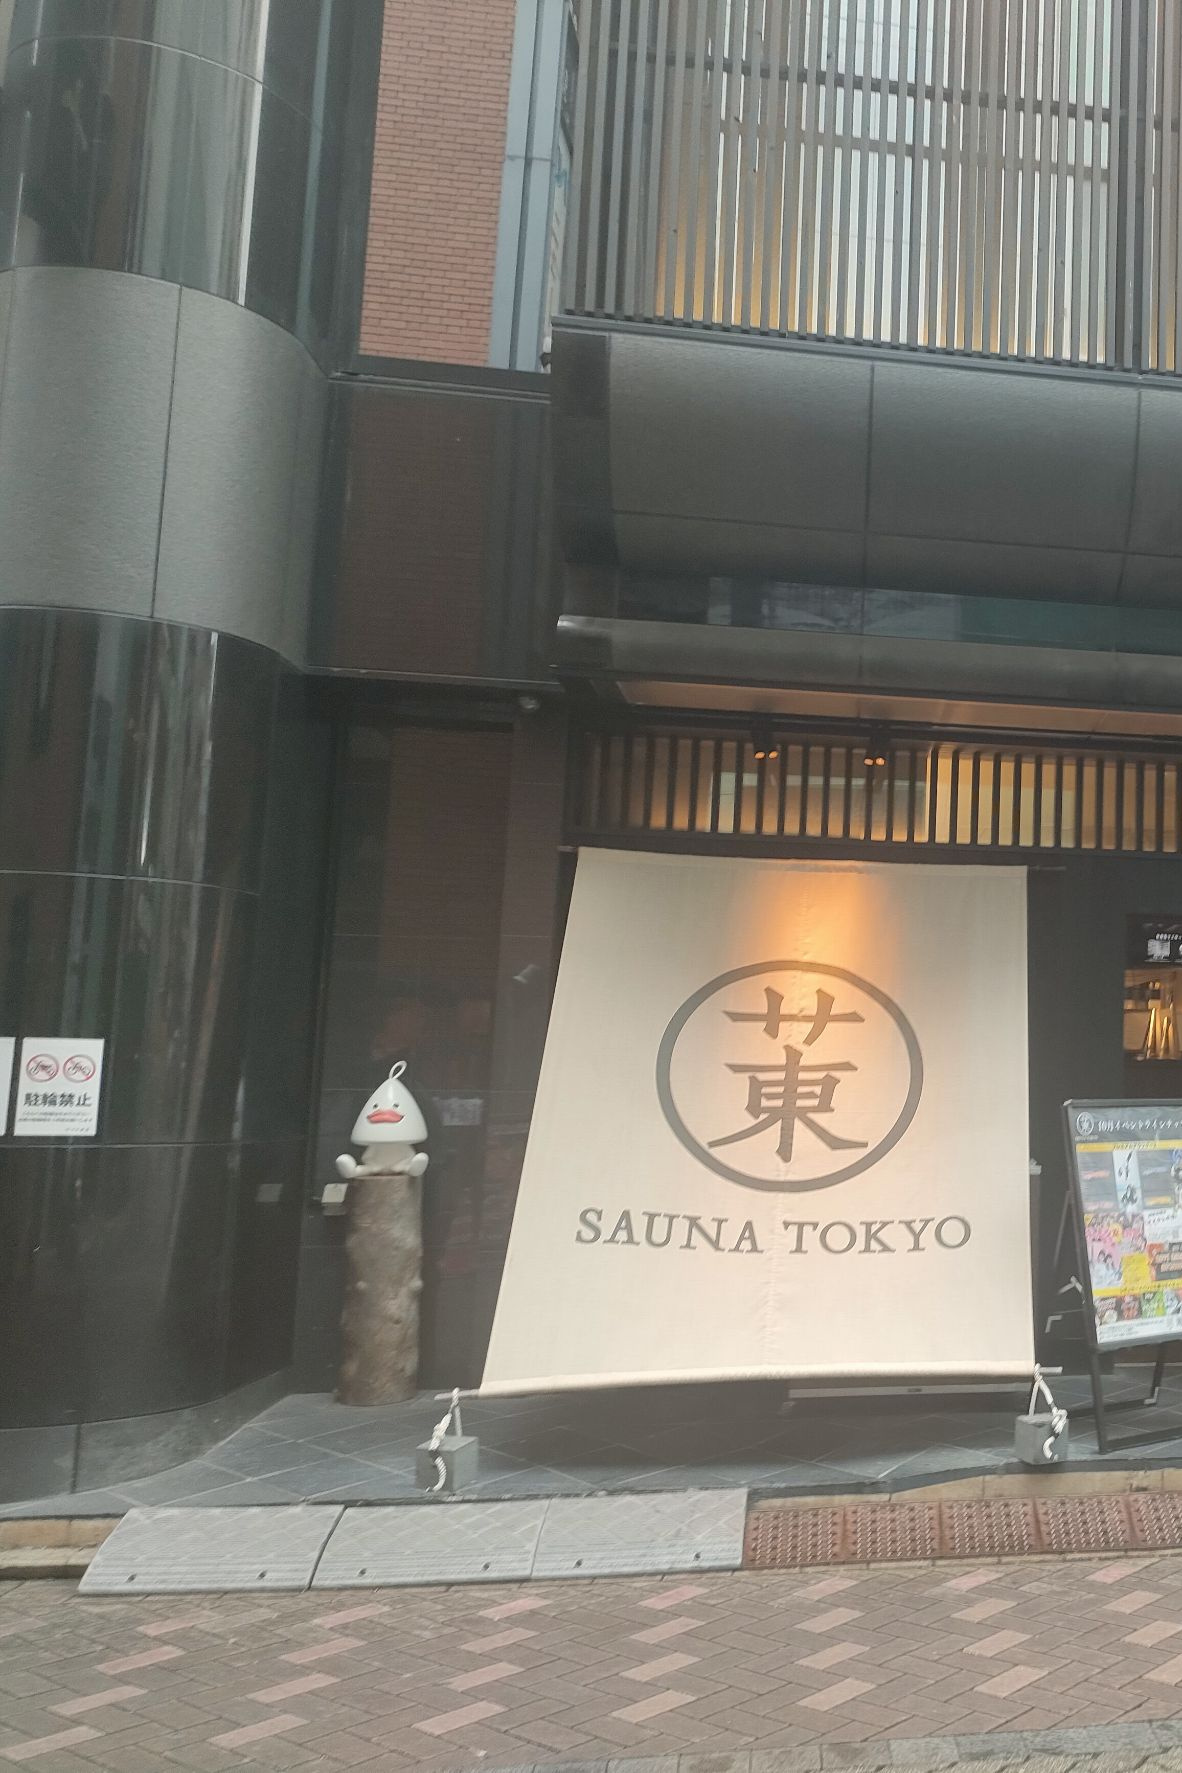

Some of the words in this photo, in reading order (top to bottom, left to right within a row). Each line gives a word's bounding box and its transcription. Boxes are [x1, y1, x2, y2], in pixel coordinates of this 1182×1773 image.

[23, 1091, 92, 1108] 駐輪禁止
[575, 1207, 764, 1255] SAUNA
[783, 1215, 972, 1255] TOKYO
